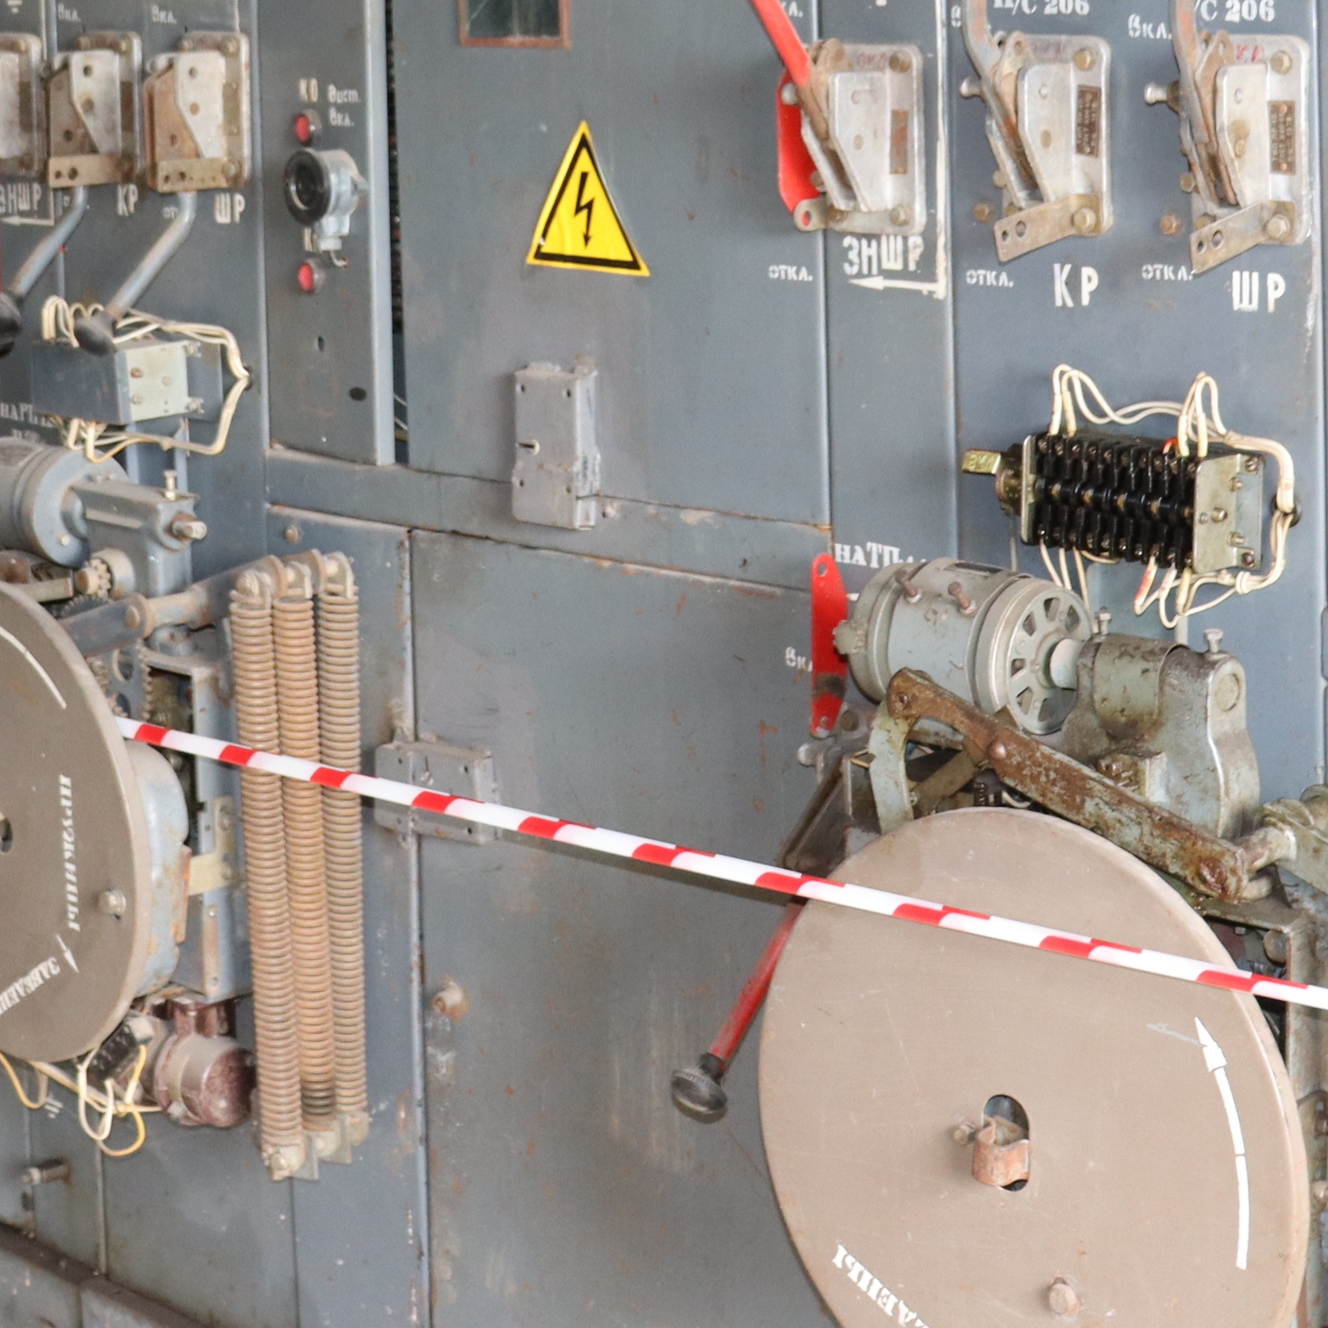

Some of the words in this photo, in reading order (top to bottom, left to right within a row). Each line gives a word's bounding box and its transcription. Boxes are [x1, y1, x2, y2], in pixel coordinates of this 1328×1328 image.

[116, 186, 140, 216] КР
[214, 192, 246, 224] ШР
[842, 234, 923, 276] ЗНШР
[1053, 264, 1100, 308] КР
[1232, 270, 1286, 312] ШР
